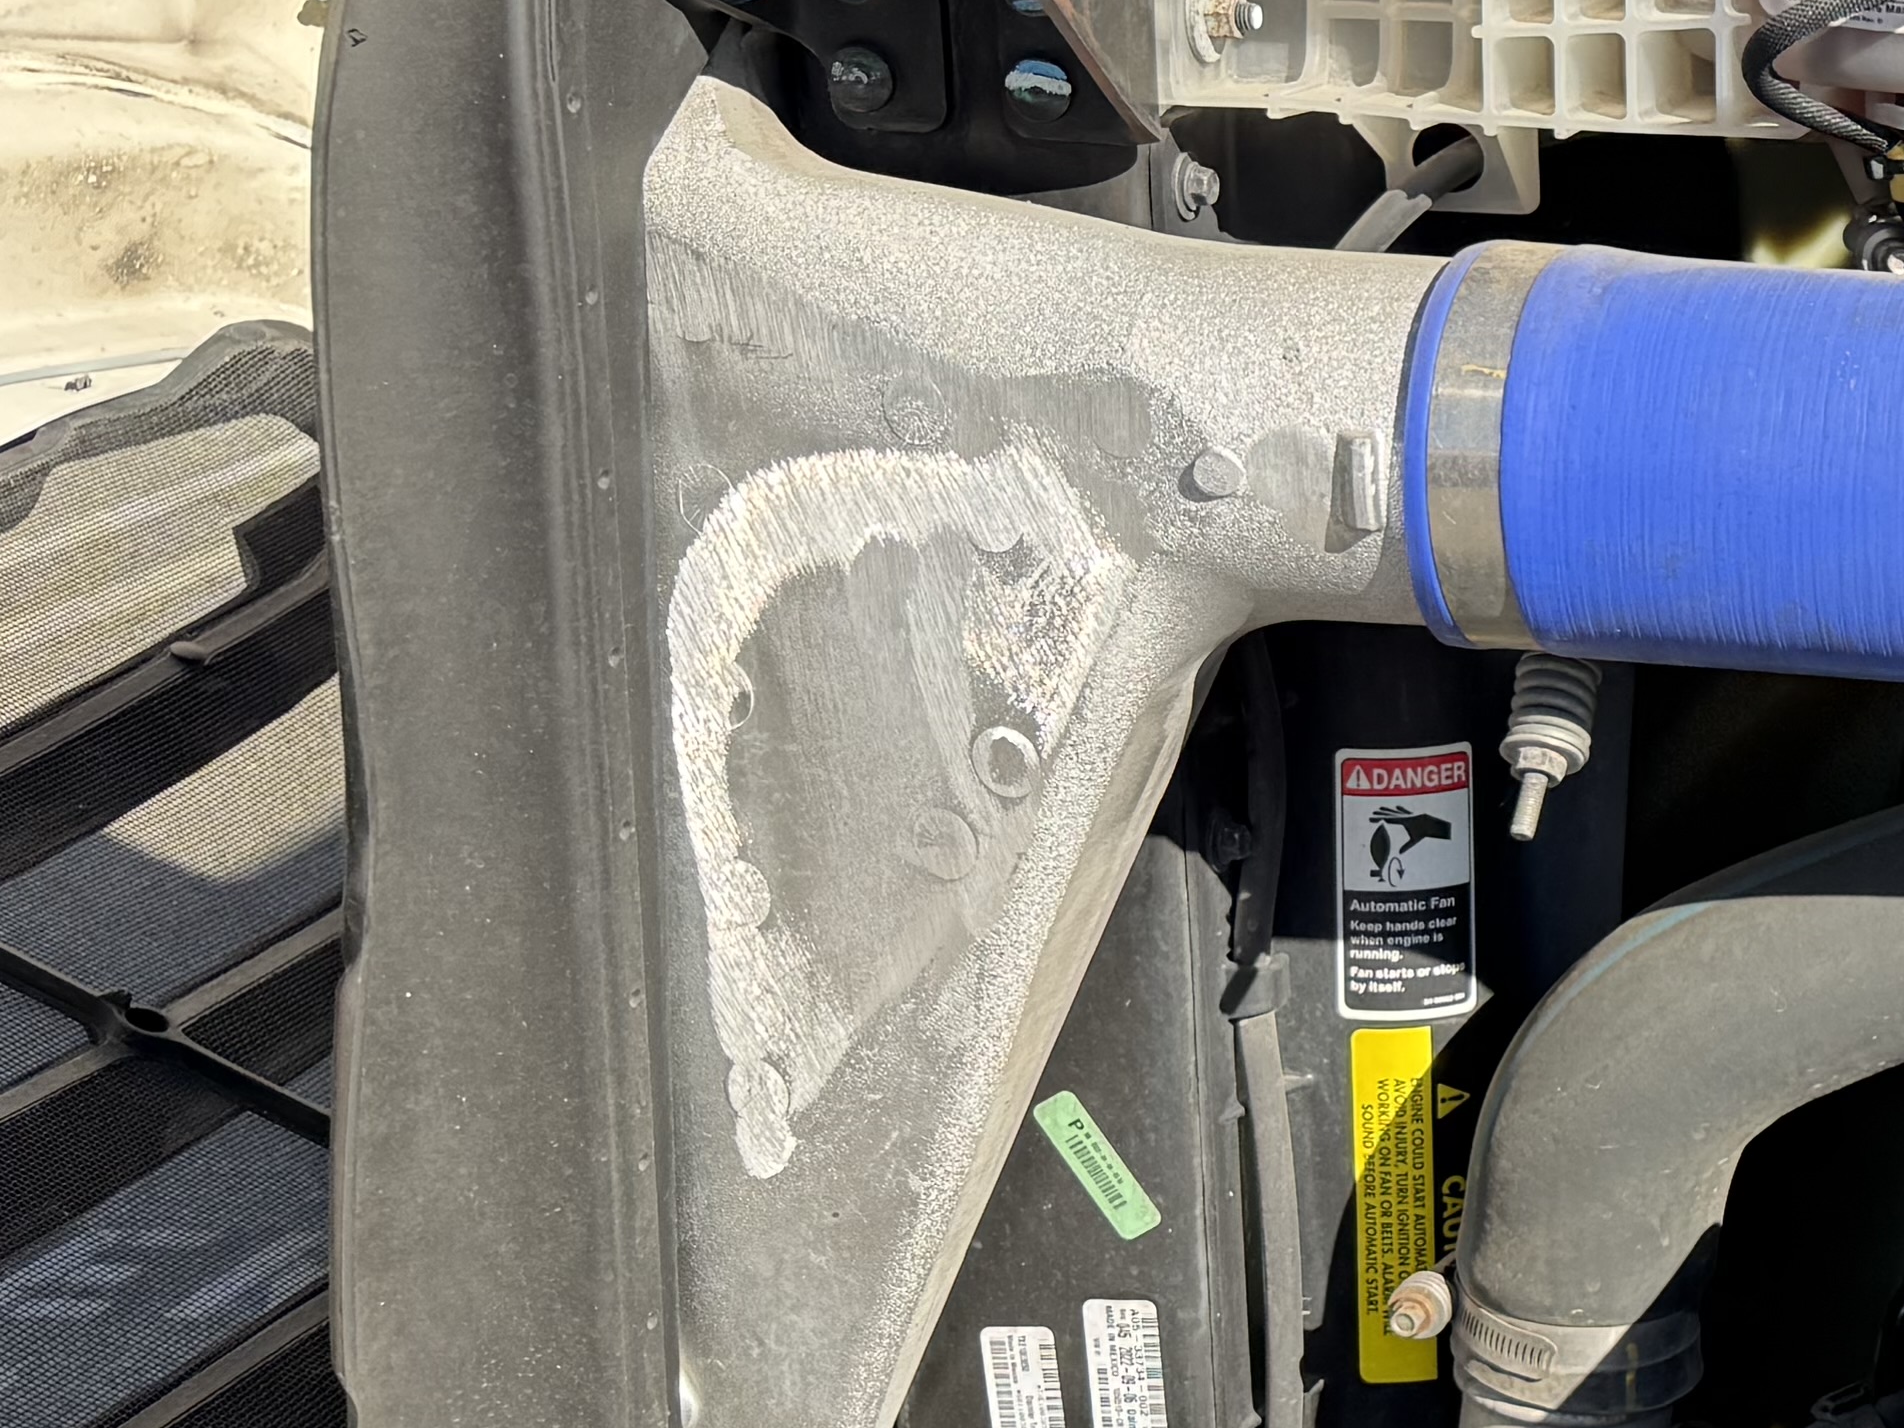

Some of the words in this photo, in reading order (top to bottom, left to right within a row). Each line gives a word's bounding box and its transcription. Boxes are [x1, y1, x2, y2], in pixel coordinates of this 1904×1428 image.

[1373, 761, 1466, 790] DANGER
[1350, 898, 1426, 912] Automatic
[1430, 897, 1455, 909] Fan
[1350, 935, 1383, 945] when
[1387, 936, 1430, 947] engine
[1433, 933, 1443, 942] is
[1351, 920, 1382, 933] Keep
[1386, 919, 1425, 932] hands
[1430, 916, 1456, 928] clear
[1350, 949, 1403, 962] running.
[1351, 966, 1373, 979] Fan
[1376, 965, 1414, 979] starts
[1417, 967, 1430, 977] or
[1434, 962, 1465, 976] stops
[1351, 982, 1366, 994] by
[1369, 981, 1405, 993] itself.
[1377, 1078, 1390, 1142] WORKING
[1393, 1078, 1406, 1117] AVOID
[1068, 1118, 1084, 1130] P
[1361, 1103, 1374, 1148] SOUND
[1379, 1145, 1391, 1166] ON
[1394, 1120, 1408, 1168] INJURY,
[1412, 1129, 1424, 1171] COULD
[1380, 1169, 1392, 1197] FAN
[1396, 1172, 1408, 1204] TURN
[1413, 1175, 1425, 1210] START
[1380, 1200, 1392, 1218] OR
[1364, 1201, 1378, 1274] AUTOMATIC
[1381, 1222, 1394, 1258] BELTS.
[1397, 1209, 1410, 1266] IGNITION
[1366, 1277, 1379, 1315] START.
[1109, 1344, 1119, 1377] MEXICO
